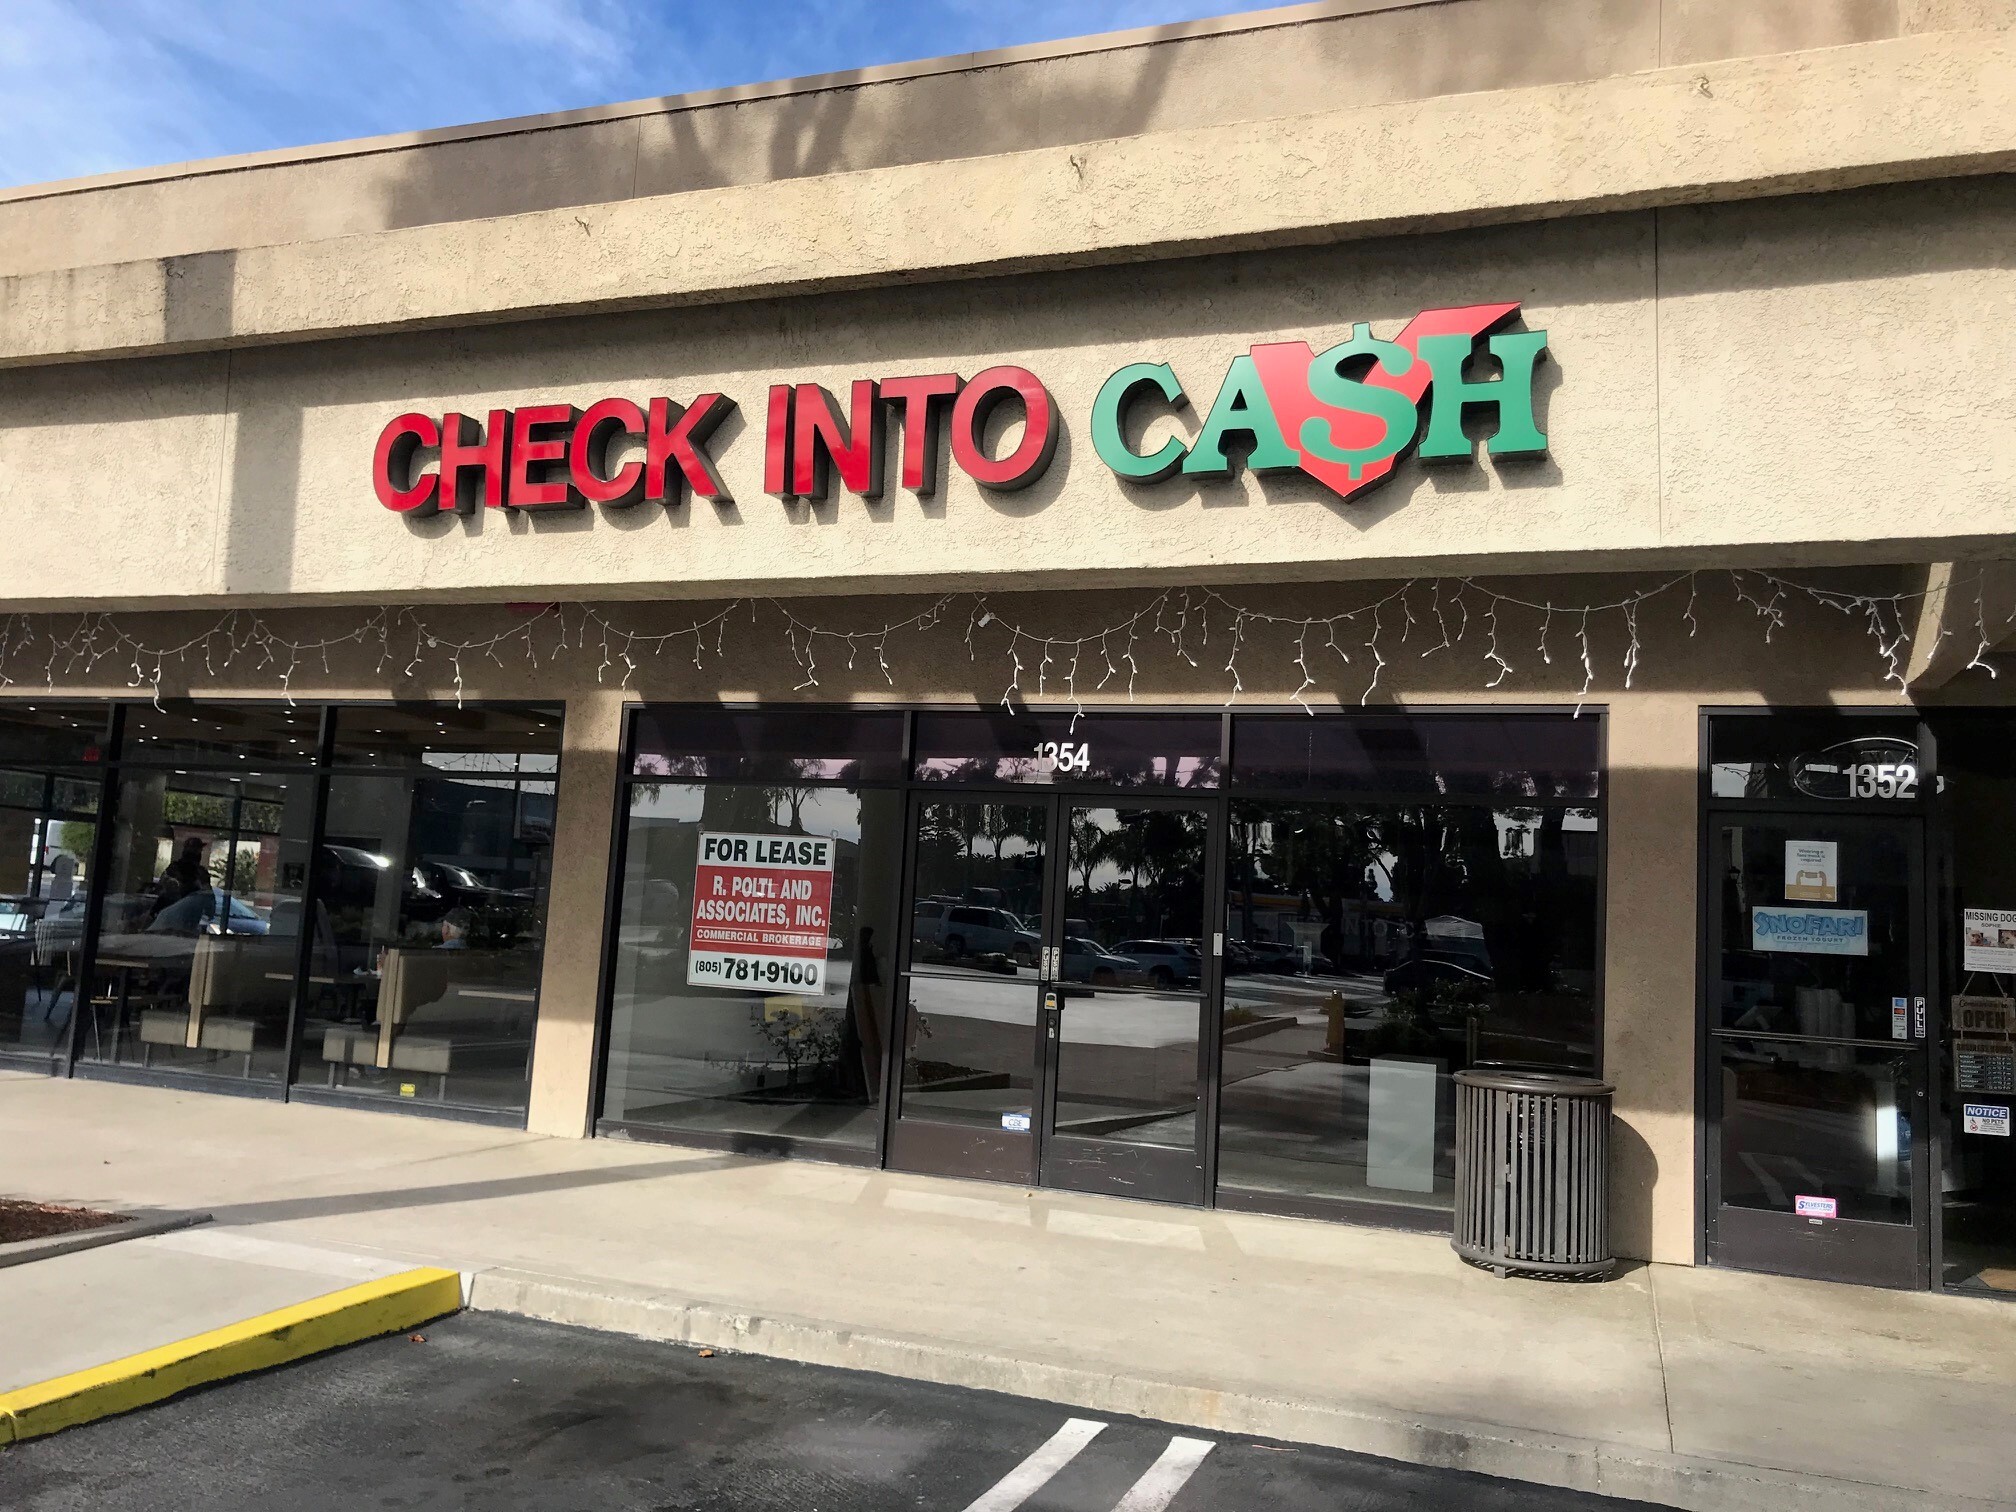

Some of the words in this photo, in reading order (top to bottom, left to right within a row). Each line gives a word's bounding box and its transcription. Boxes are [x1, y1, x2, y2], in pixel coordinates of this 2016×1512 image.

[373, 393, 736, 514] CHECK
[764, 366, 1056, 496] INTO
[1033, 741, 1091, 772] 1354
[1842, 763, 1917, 800] 1352
[704, 838, 748, 862] FOR
[755, 840, 828, 866] LEASE
[712, 876, 726, 896] R.
[732, 876, 778, 899] POLTL
[780, 879, 813, 901] AND
[696, 899, 791, 929] ASSOCIATES,
[795, 905, 826, 927] INC.
[1754, 911, 1864, 937] SNOFARI
[1965, 911, 1999, 922] MISSING
[696, 928, 759, 943] COMMERCIAL
[762, 933, 822, 947] BROKERAGE
[695, 959, 722, 976] (805)
[723, 957, 818, 986] 781-9100
[1963, 1009, 2006, 1029] OPEN
[1966, 1106, 2007, 1118] NOTICE
[1798, 1200, 1834, 1210] SYLVESTERS
